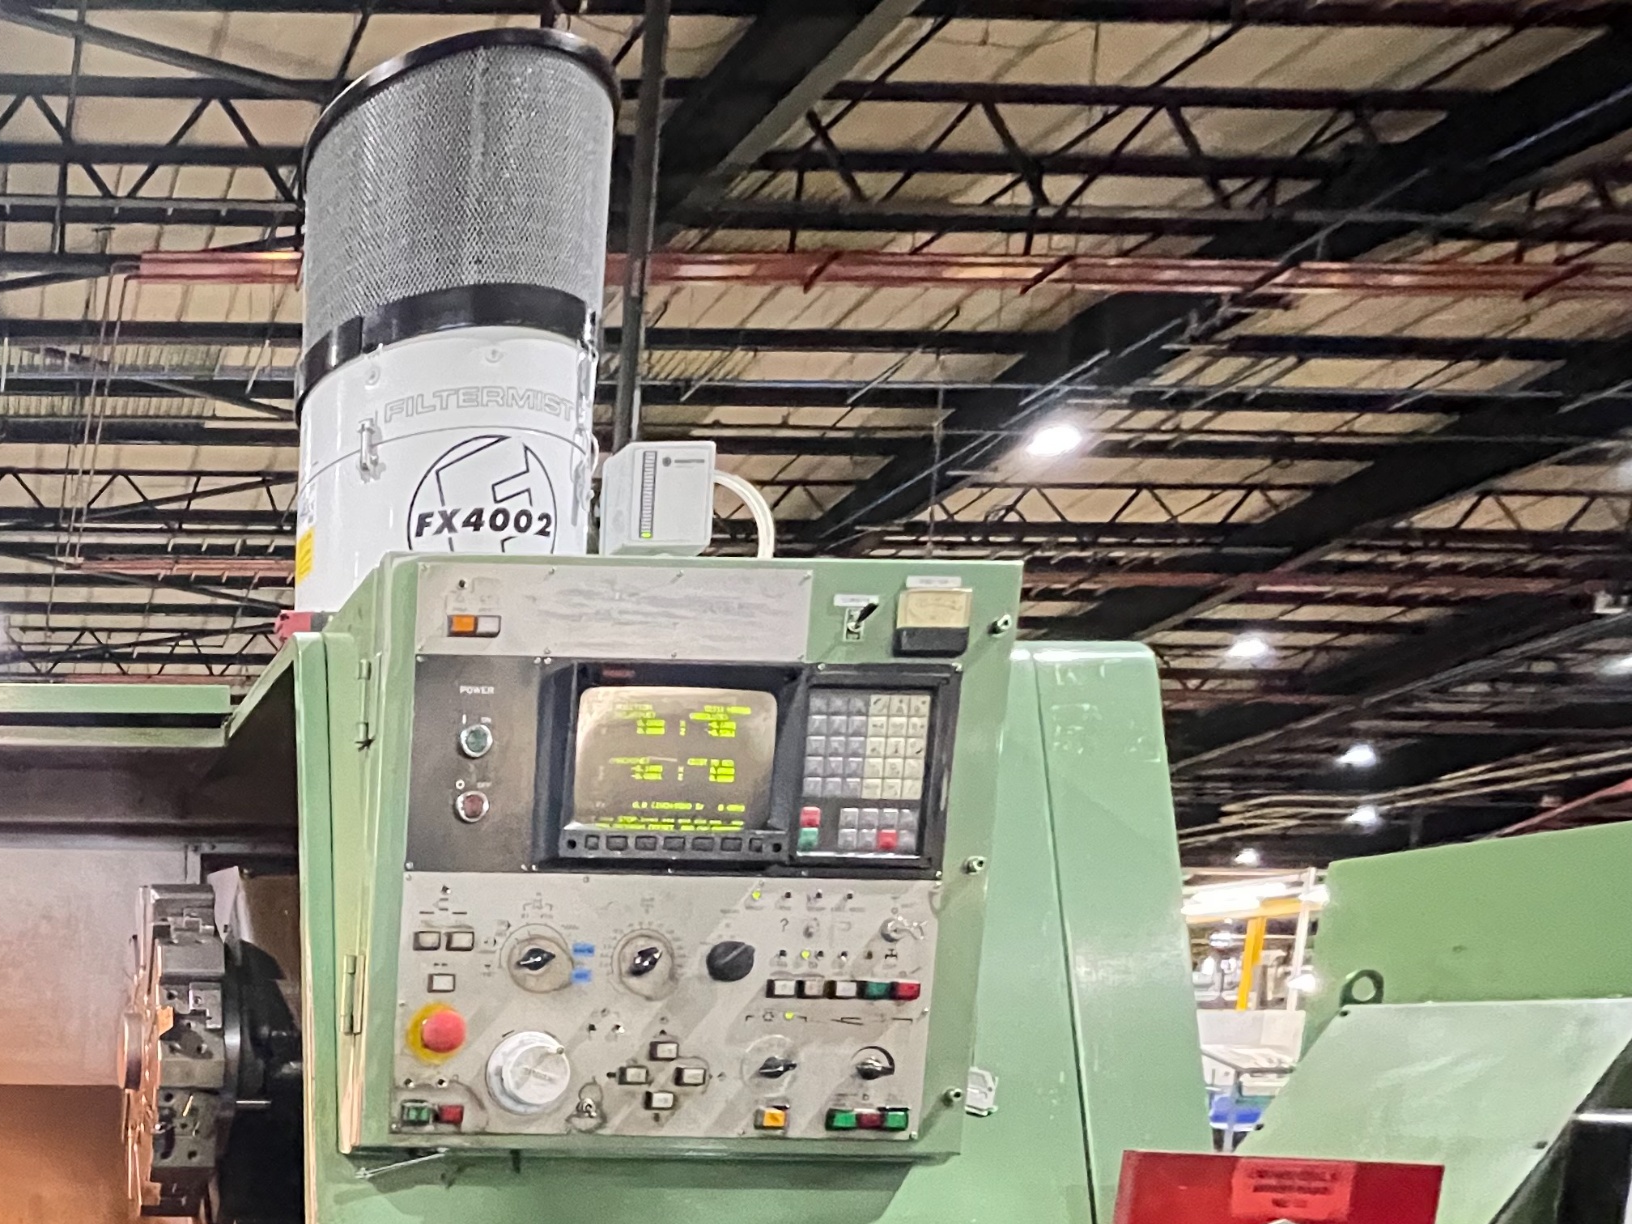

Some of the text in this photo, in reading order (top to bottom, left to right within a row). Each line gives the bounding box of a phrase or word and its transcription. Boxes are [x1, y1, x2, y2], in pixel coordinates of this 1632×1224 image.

[384, 386, 575, 423] FILTERMIST
[415, 506, 553, 539] FX4002
[459, 685, 495, 695] POWER
